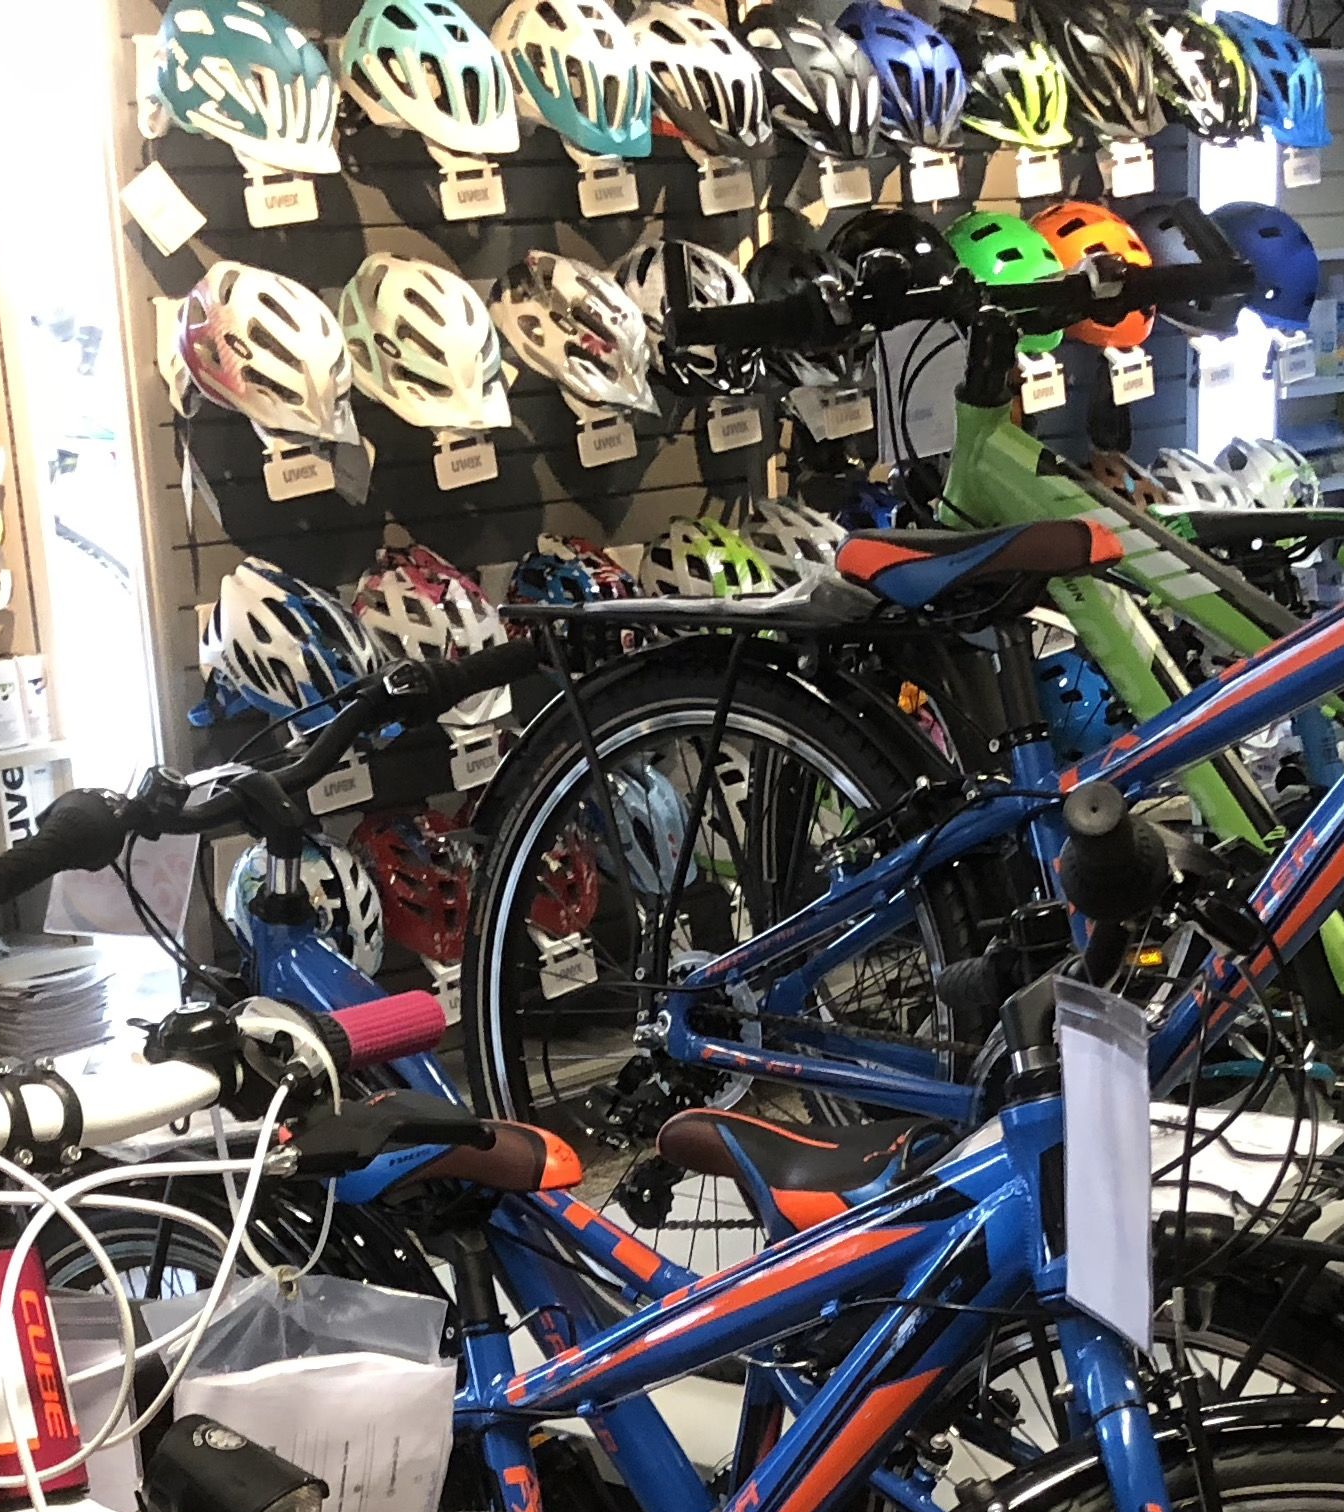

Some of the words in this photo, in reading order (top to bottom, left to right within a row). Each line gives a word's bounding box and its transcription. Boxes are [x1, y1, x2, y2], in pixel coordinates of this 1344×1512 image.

[265, 193, 298, 209] uvex
[457, 187, 490, 204] uvex
[595, 185, 624, 201] uvex
[594, 434, 622, 451] uvex
[283, 464, 318, 483] uvex
[451, 455, 482, 474] uvex
[467, 755, 497, 774] uvex
[20, 1288, 69, 1440] CUBE
